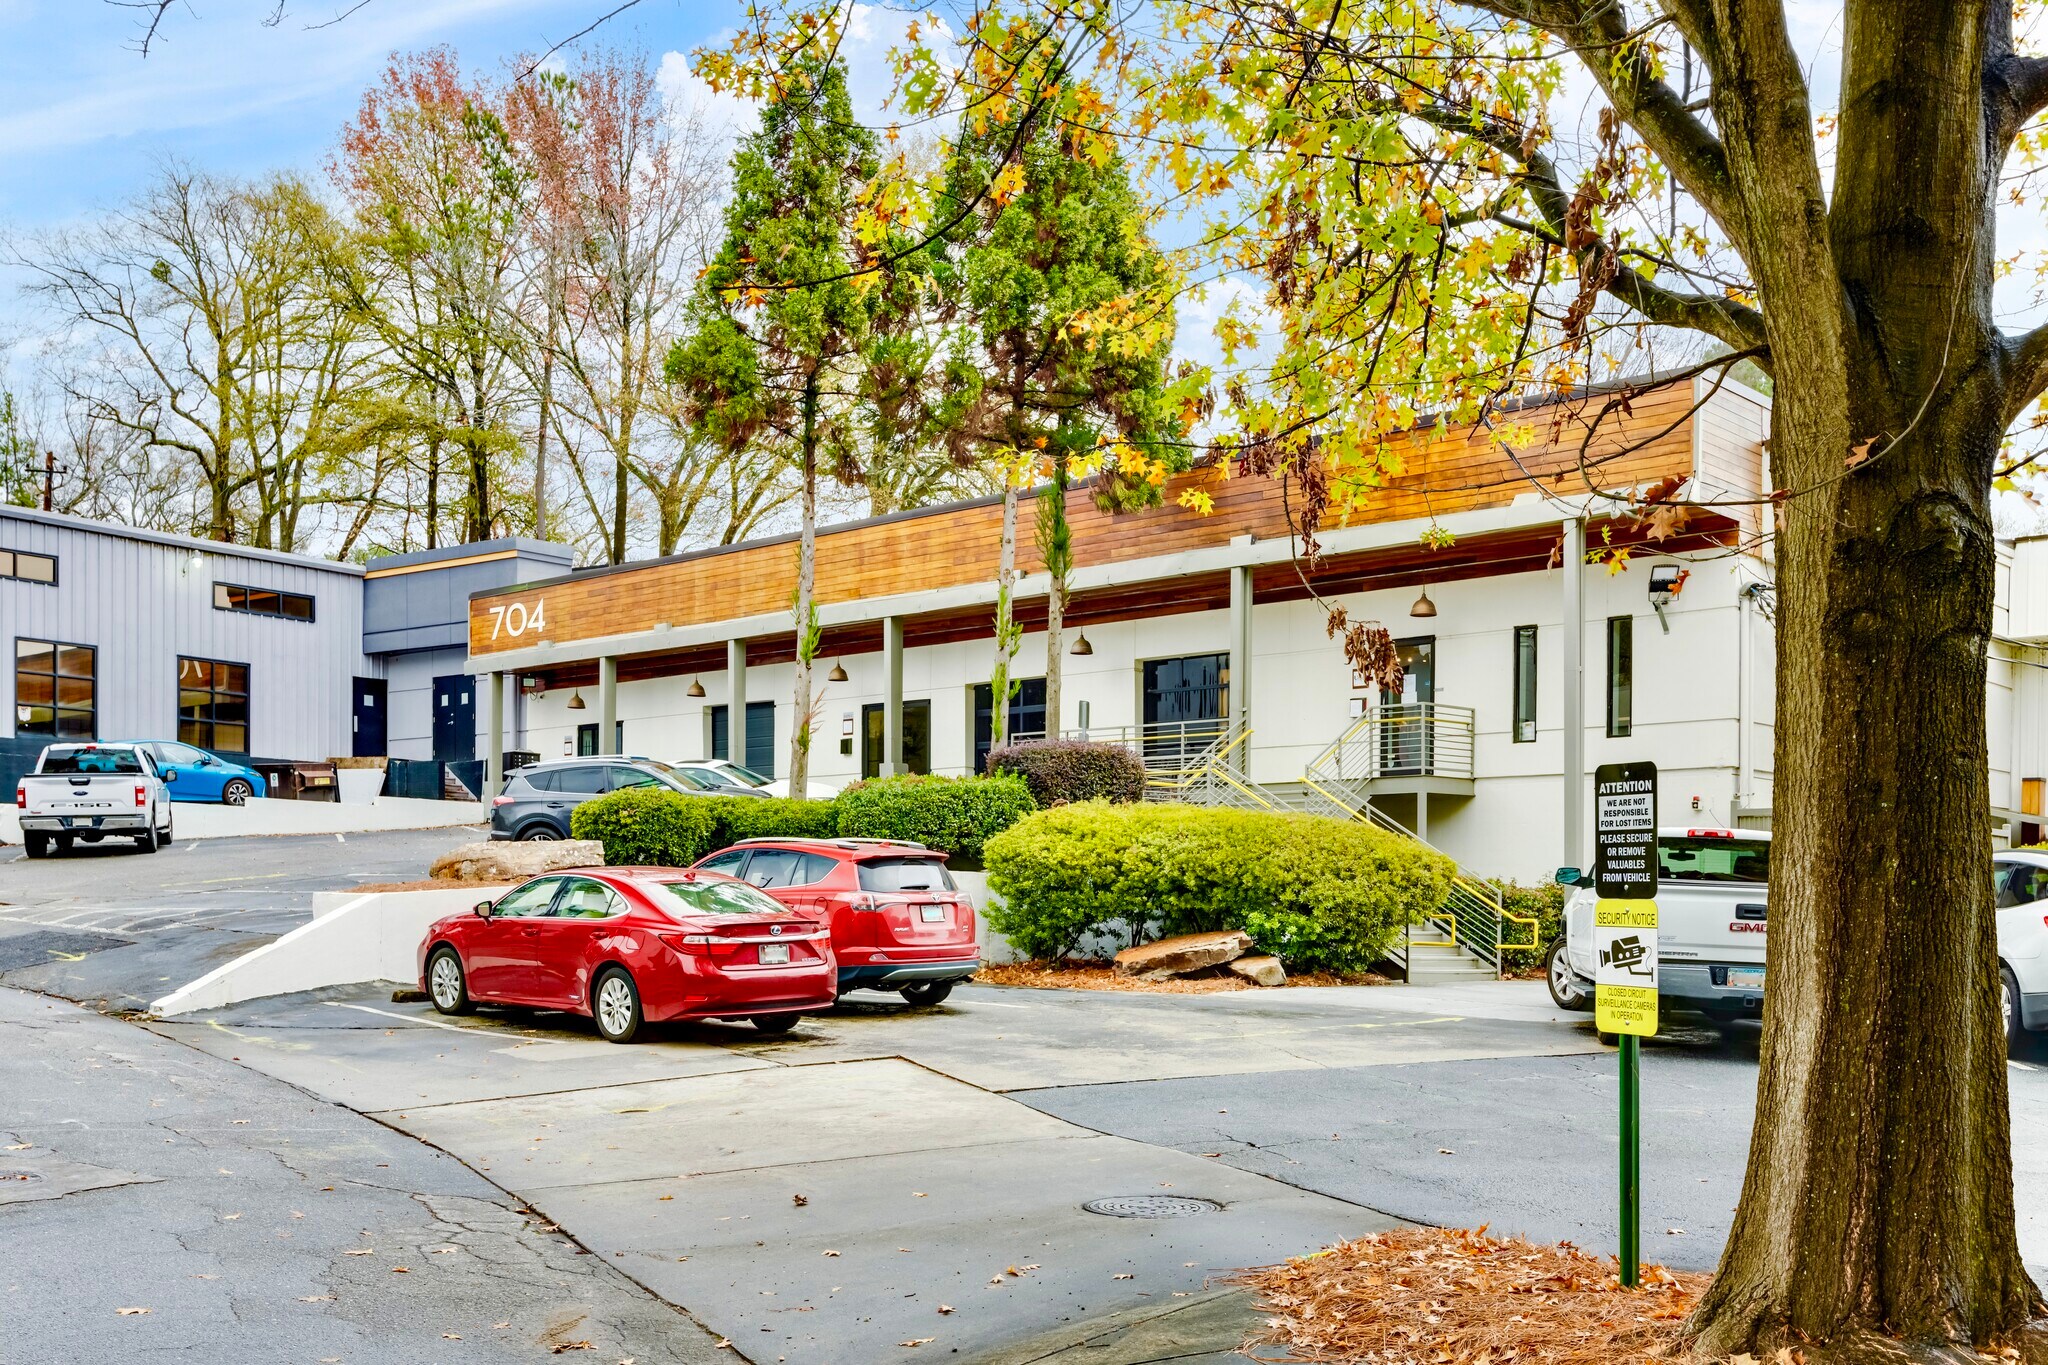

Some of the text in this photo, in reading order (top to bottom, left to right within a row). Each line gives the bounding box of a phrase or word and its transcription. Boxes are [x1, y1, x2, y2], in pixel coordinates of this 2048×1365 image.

[489, 597, 546, 640] 704
[1599, 780, 1652, 794] ATTENTION
[1607, 799, 1617, 807] WE
[1604, 808, 1648, 817] RESPONSIBLE
[1615, 819, 1631, 827] LOST
[1632, 818, 1651, 826] ITEMS
[1600, 833, 1653, 844] PLEASE SECURE
[1607, 847, 1645, 856] OR REMOVE
[1607, 860, 1645, 869] VALUABLES
[1602, 873, 1650, 882] FROM VEHICLE
[1598, 912, 1655, 926] SECURITY NOTICE
[1608, 987, 1646, 998] CLOSED CIRCUIT
[1597, 998, 1656, 1011] SURVEILLANCE CAMERAS
[1611, 1011, 1643, 1021] IN OPERATION
